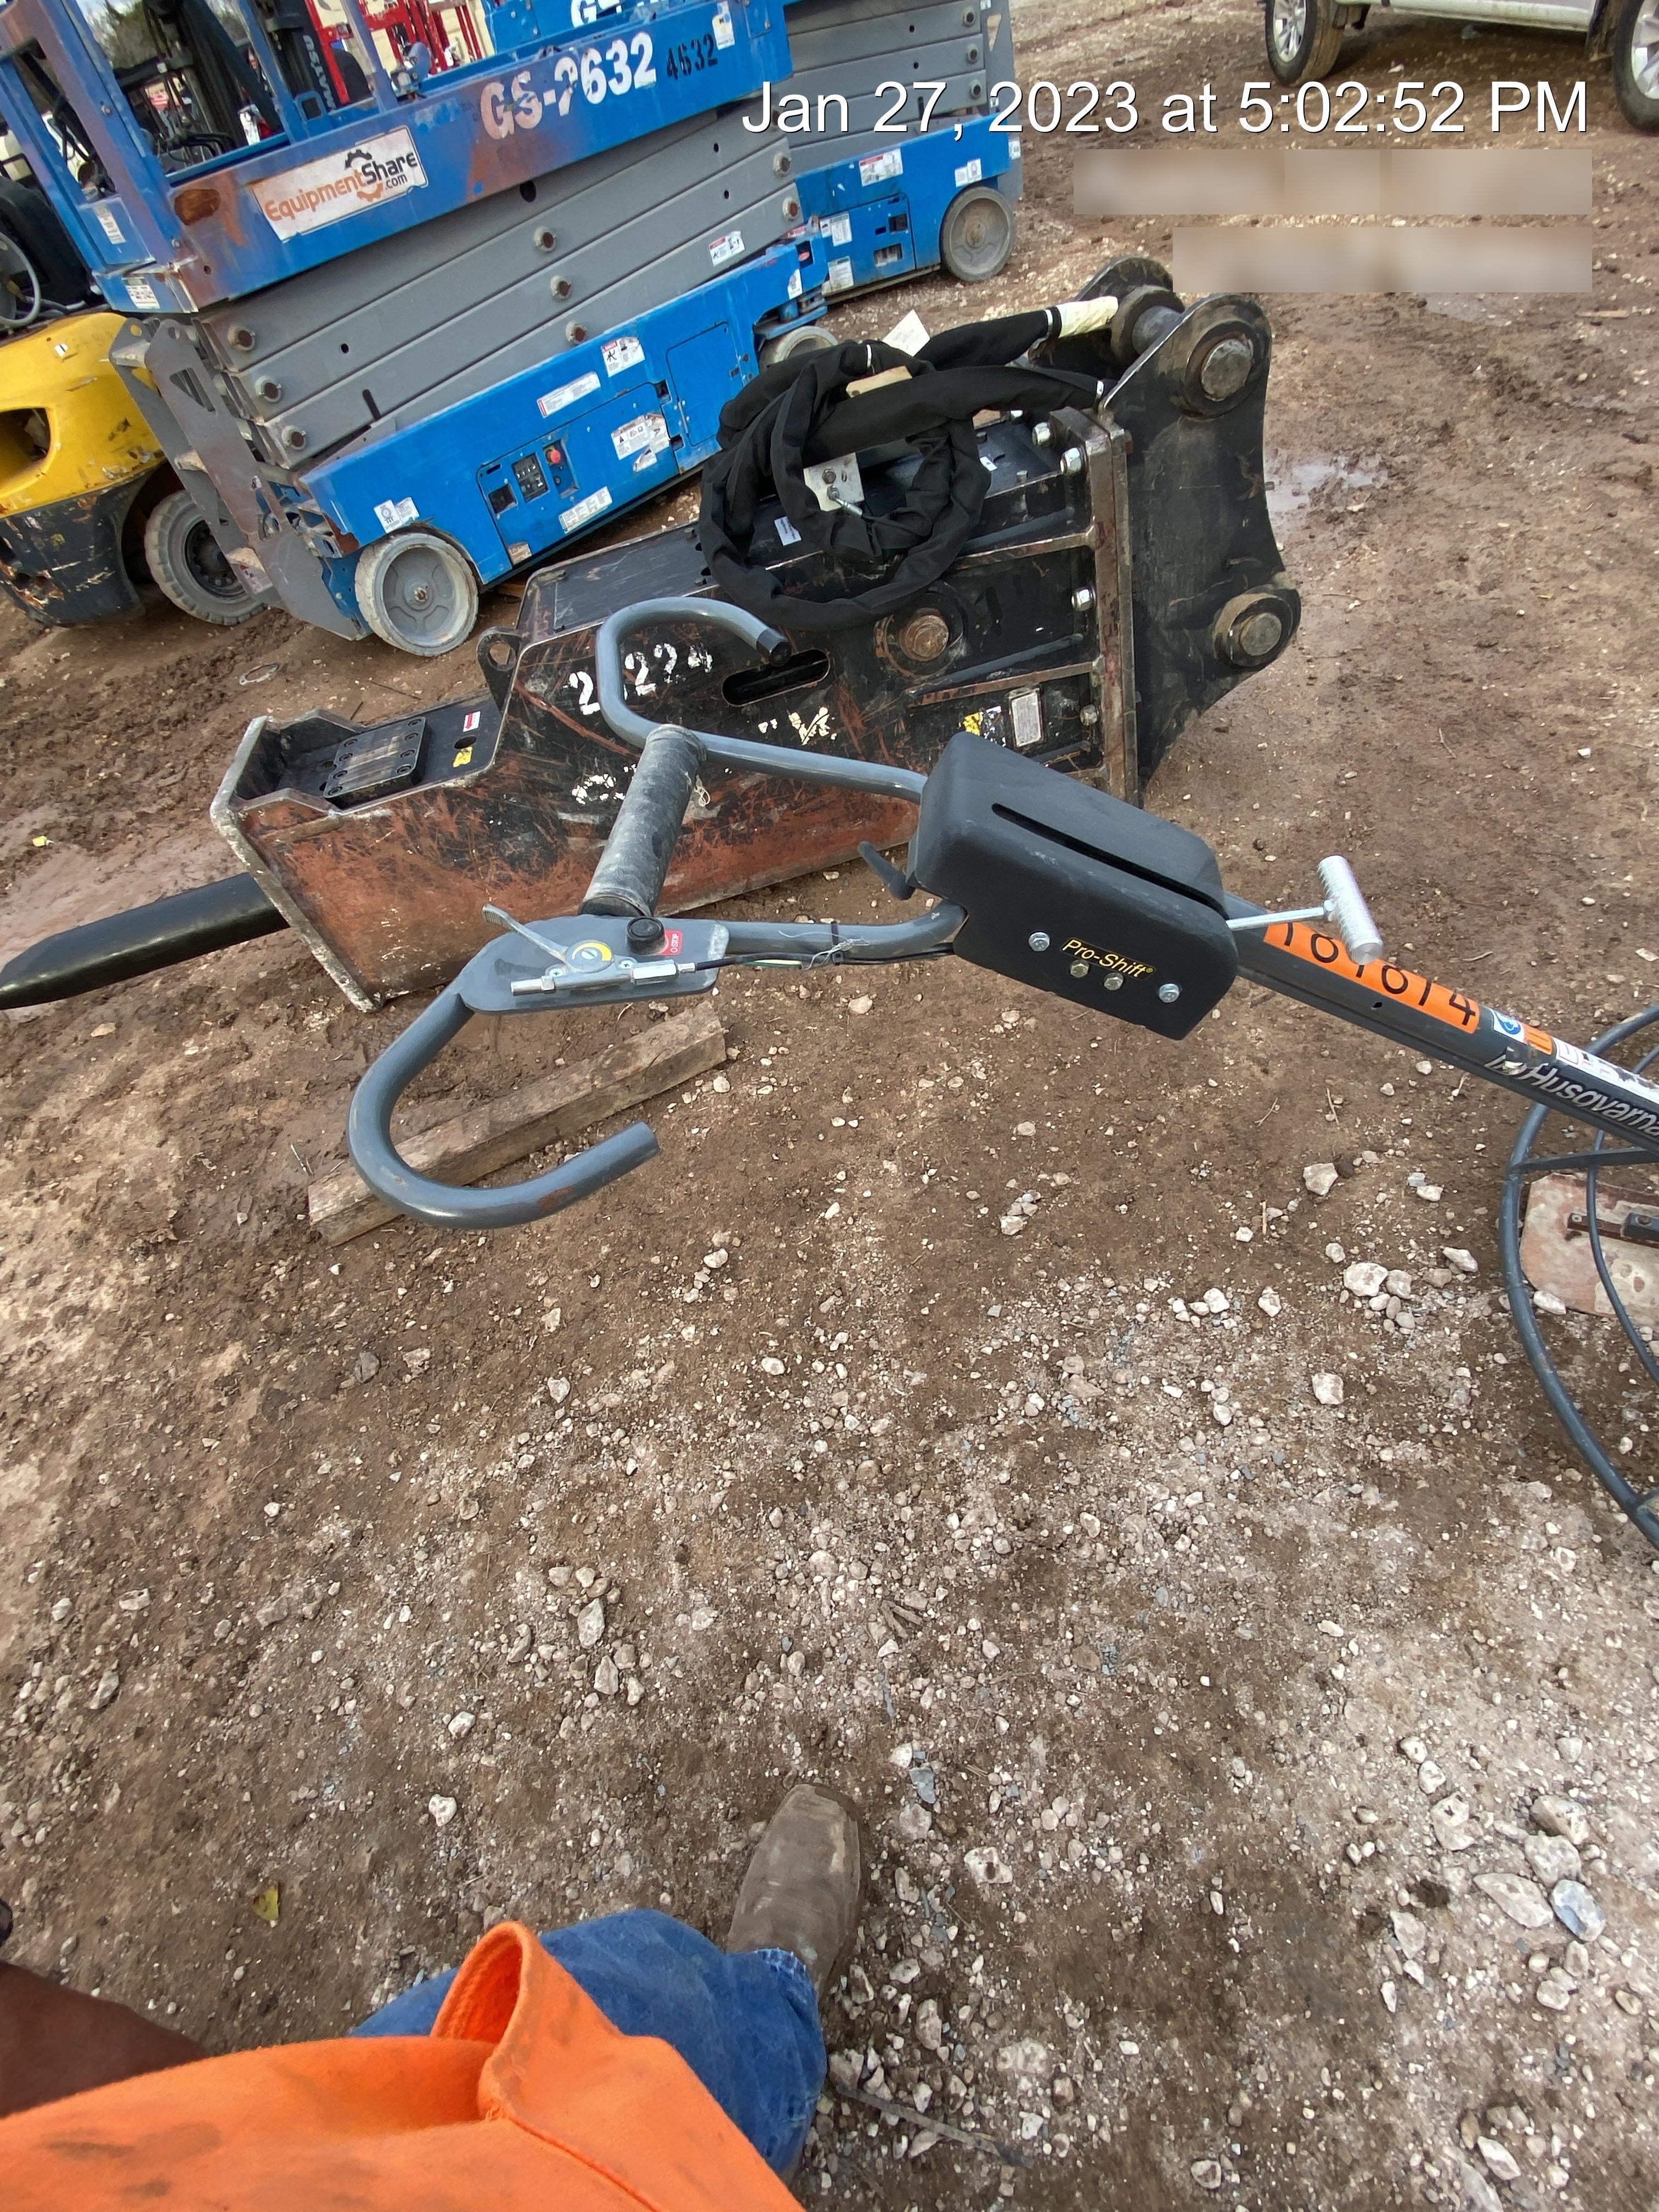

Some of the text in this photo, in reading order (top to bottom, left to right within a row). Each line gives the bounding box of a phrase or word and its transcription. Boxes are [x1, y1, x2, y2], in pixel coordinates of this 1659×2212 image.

[667, 33, 718, 80] 4632
[670, 933, 680, 948] STOP
[1062, 939, 1146, 977] Pro-Shift
